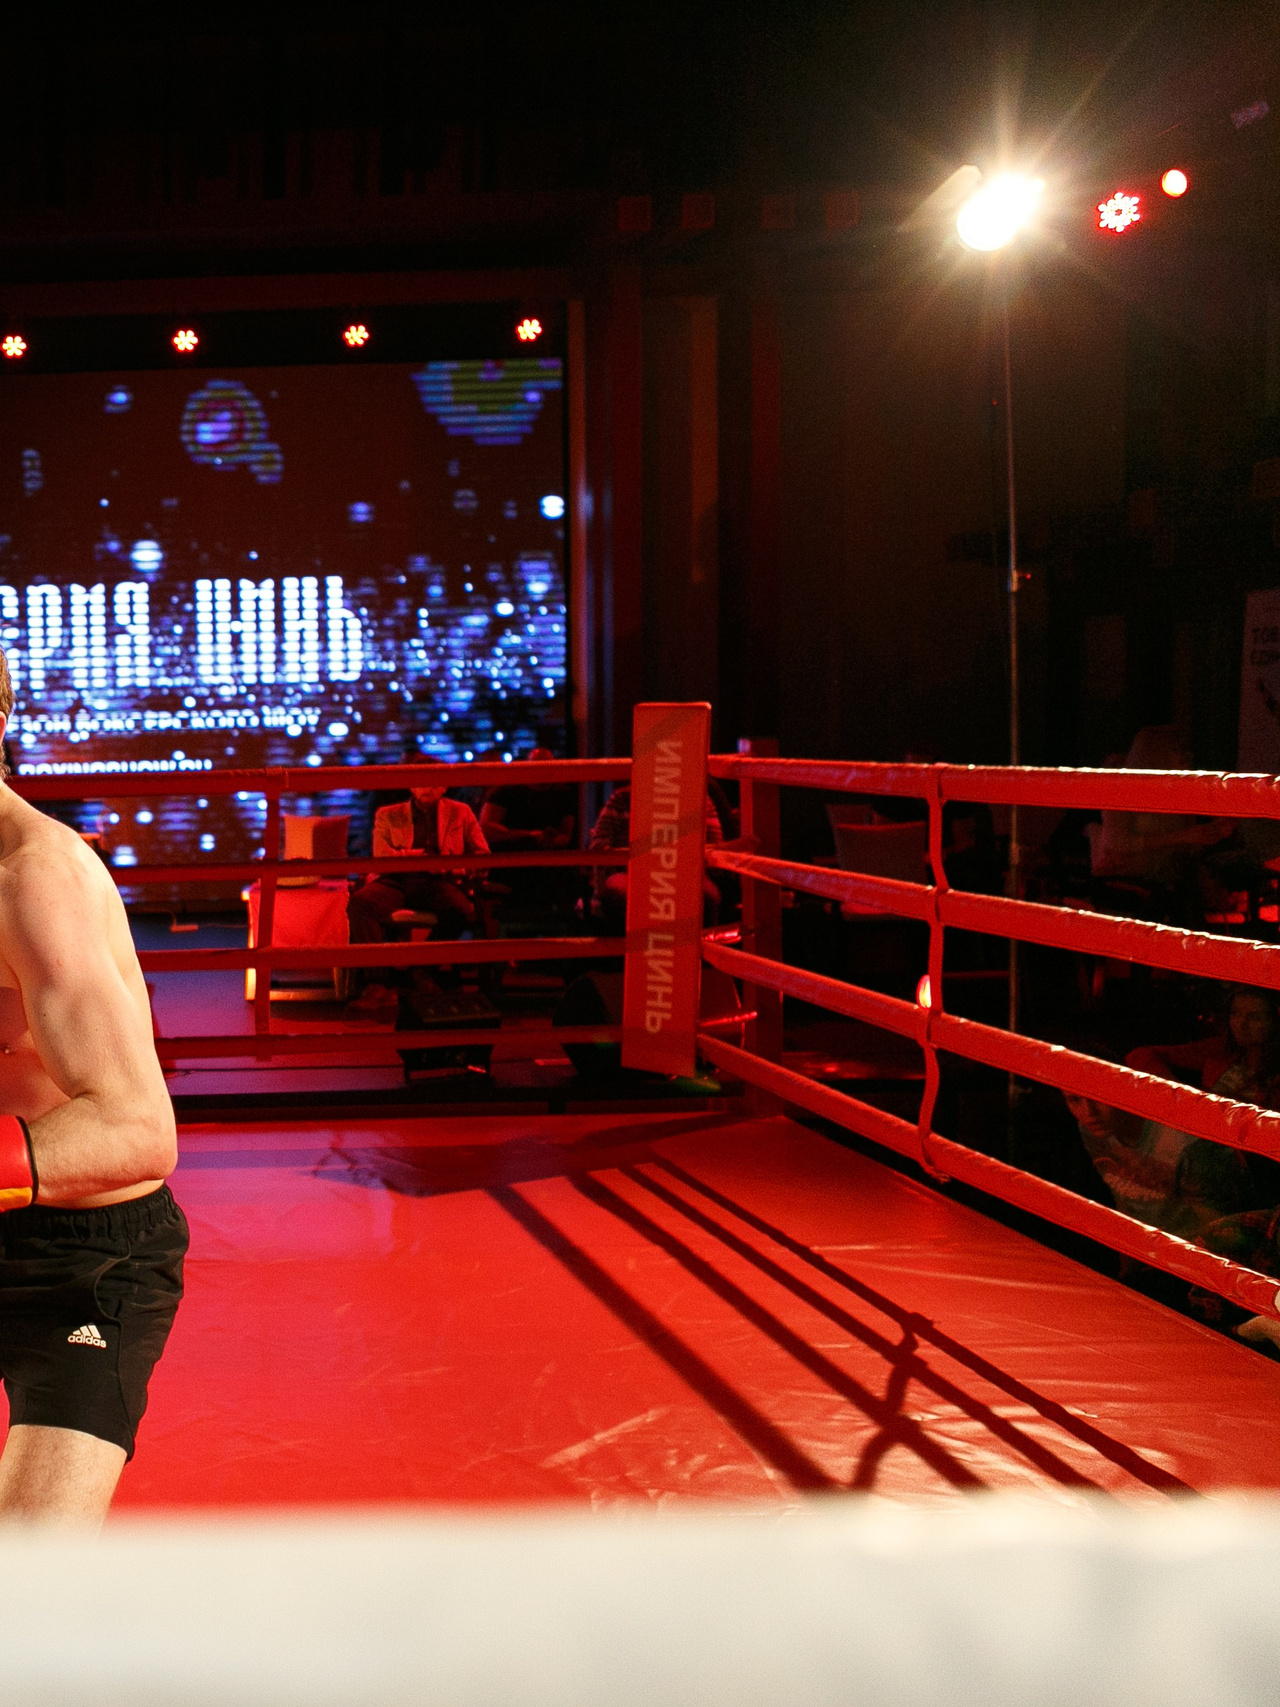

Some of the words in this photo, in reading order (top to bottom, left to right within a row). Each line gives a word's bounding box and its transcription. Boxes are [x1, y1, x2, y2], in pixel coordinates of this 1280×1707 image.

[195, 575, 364, 685] ЦИНЬ
[648, 739, 684, 922] ИМПЕРИЯ
[644, 934, 676, 1035] ЦИНЬ
[67, 1335, 107, 1349] adidas
